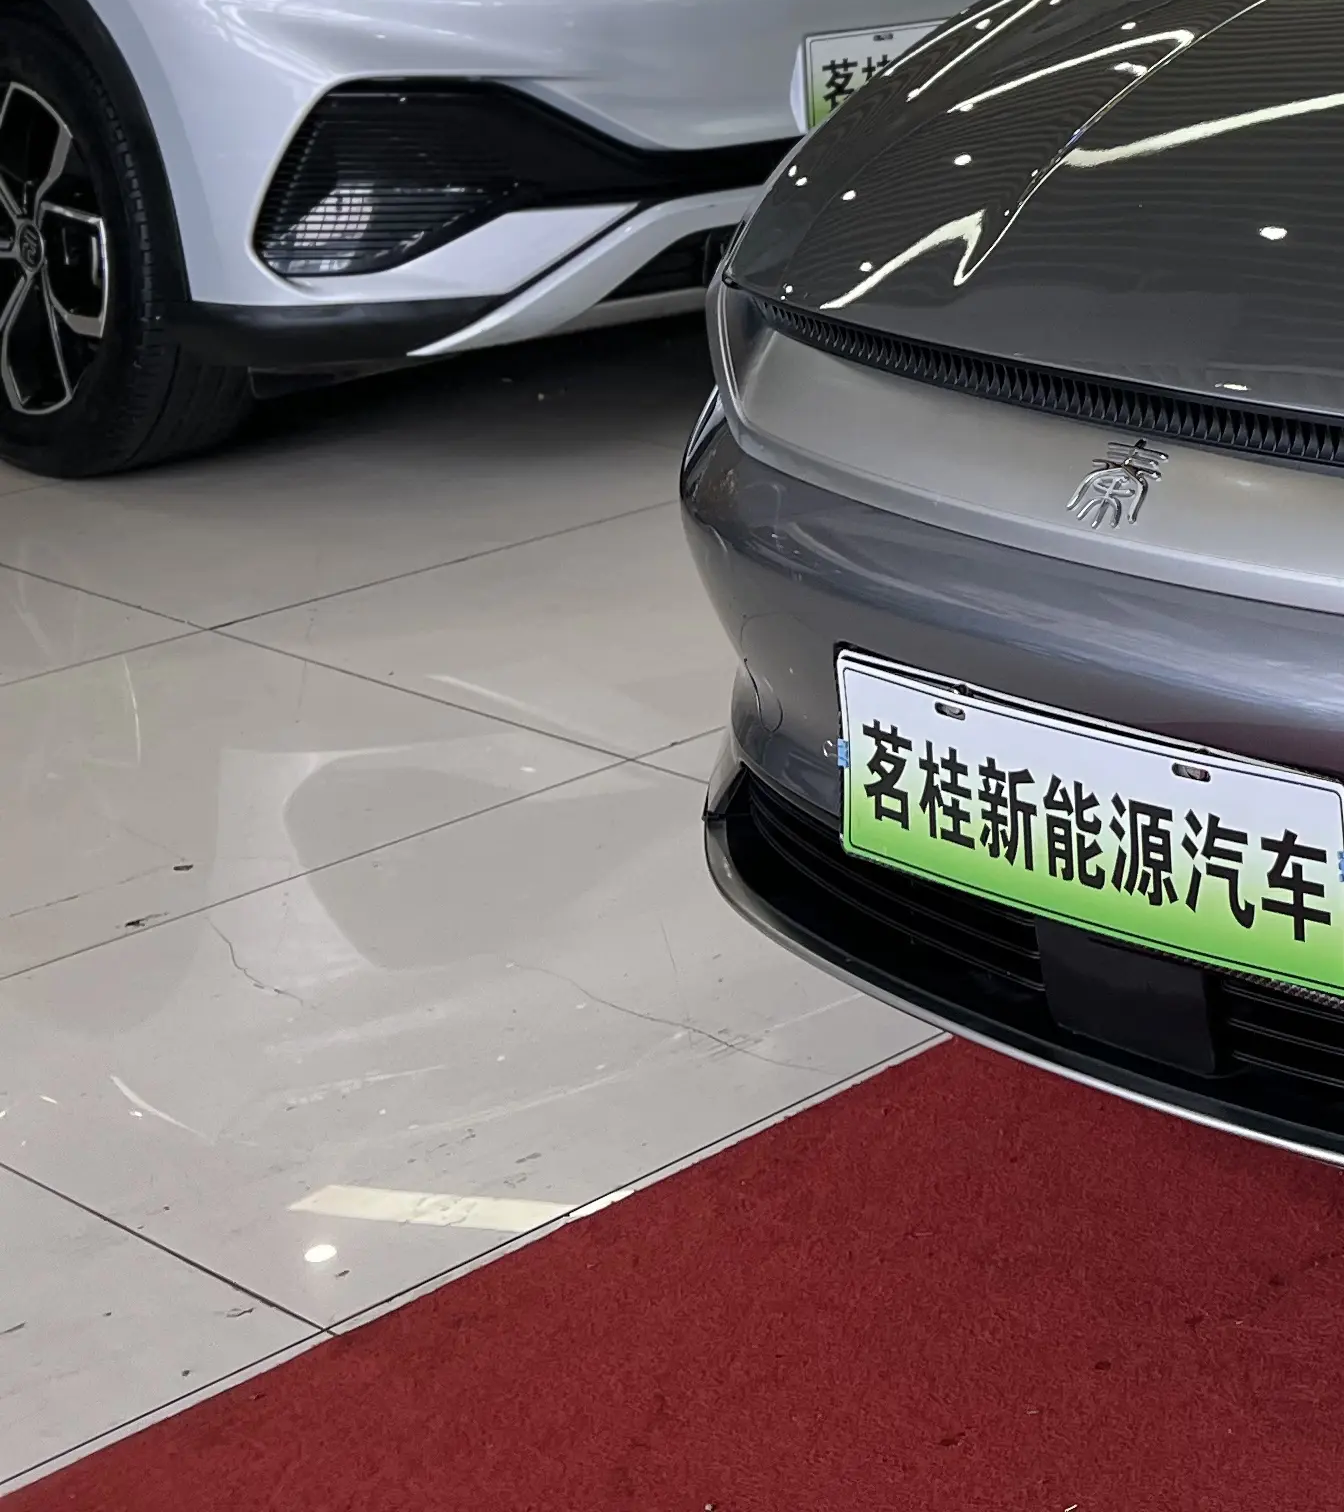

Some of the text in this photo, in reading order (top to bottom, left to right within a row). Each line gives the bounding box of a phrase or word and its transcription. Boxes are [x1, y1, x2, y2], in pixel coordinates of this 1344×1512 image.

[861, 718, 1332, 943] 茗桂新能源汽车
